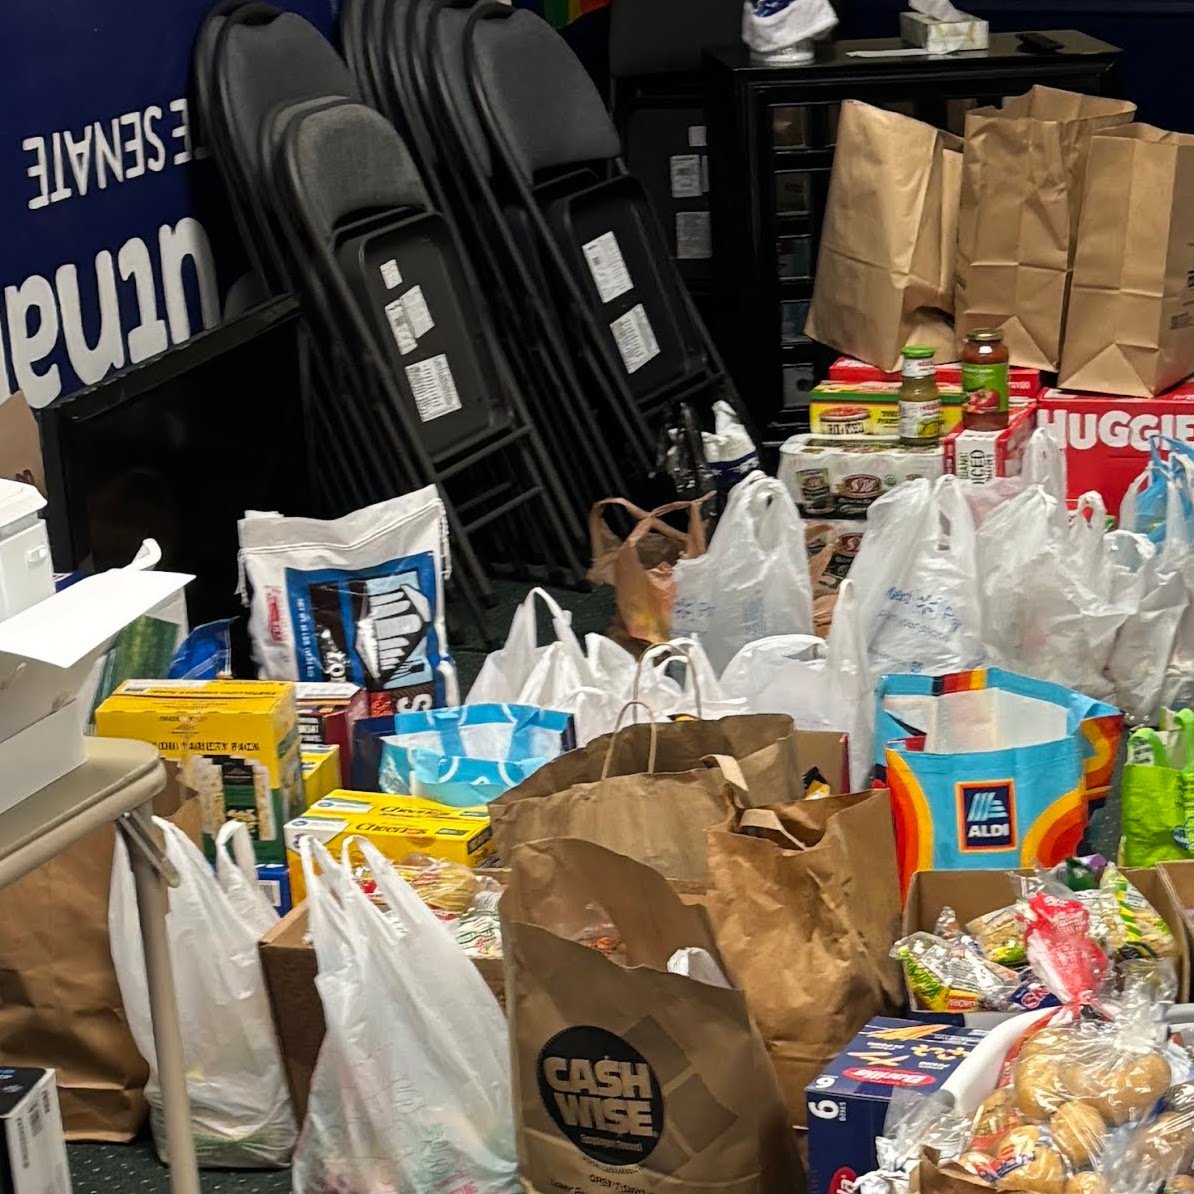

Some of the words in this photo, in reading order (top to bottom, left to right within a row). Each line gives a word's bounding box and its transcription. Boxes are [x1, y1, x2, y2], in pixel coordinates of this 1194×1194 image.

[22, 105, 167, 210] SENATE
[0, 217, 222, 409] utna
[967, 824, 1010, 838] ALDI
[554, 1091, 656, 1138] WISE
[808, 1099, 839, 1120] 6
